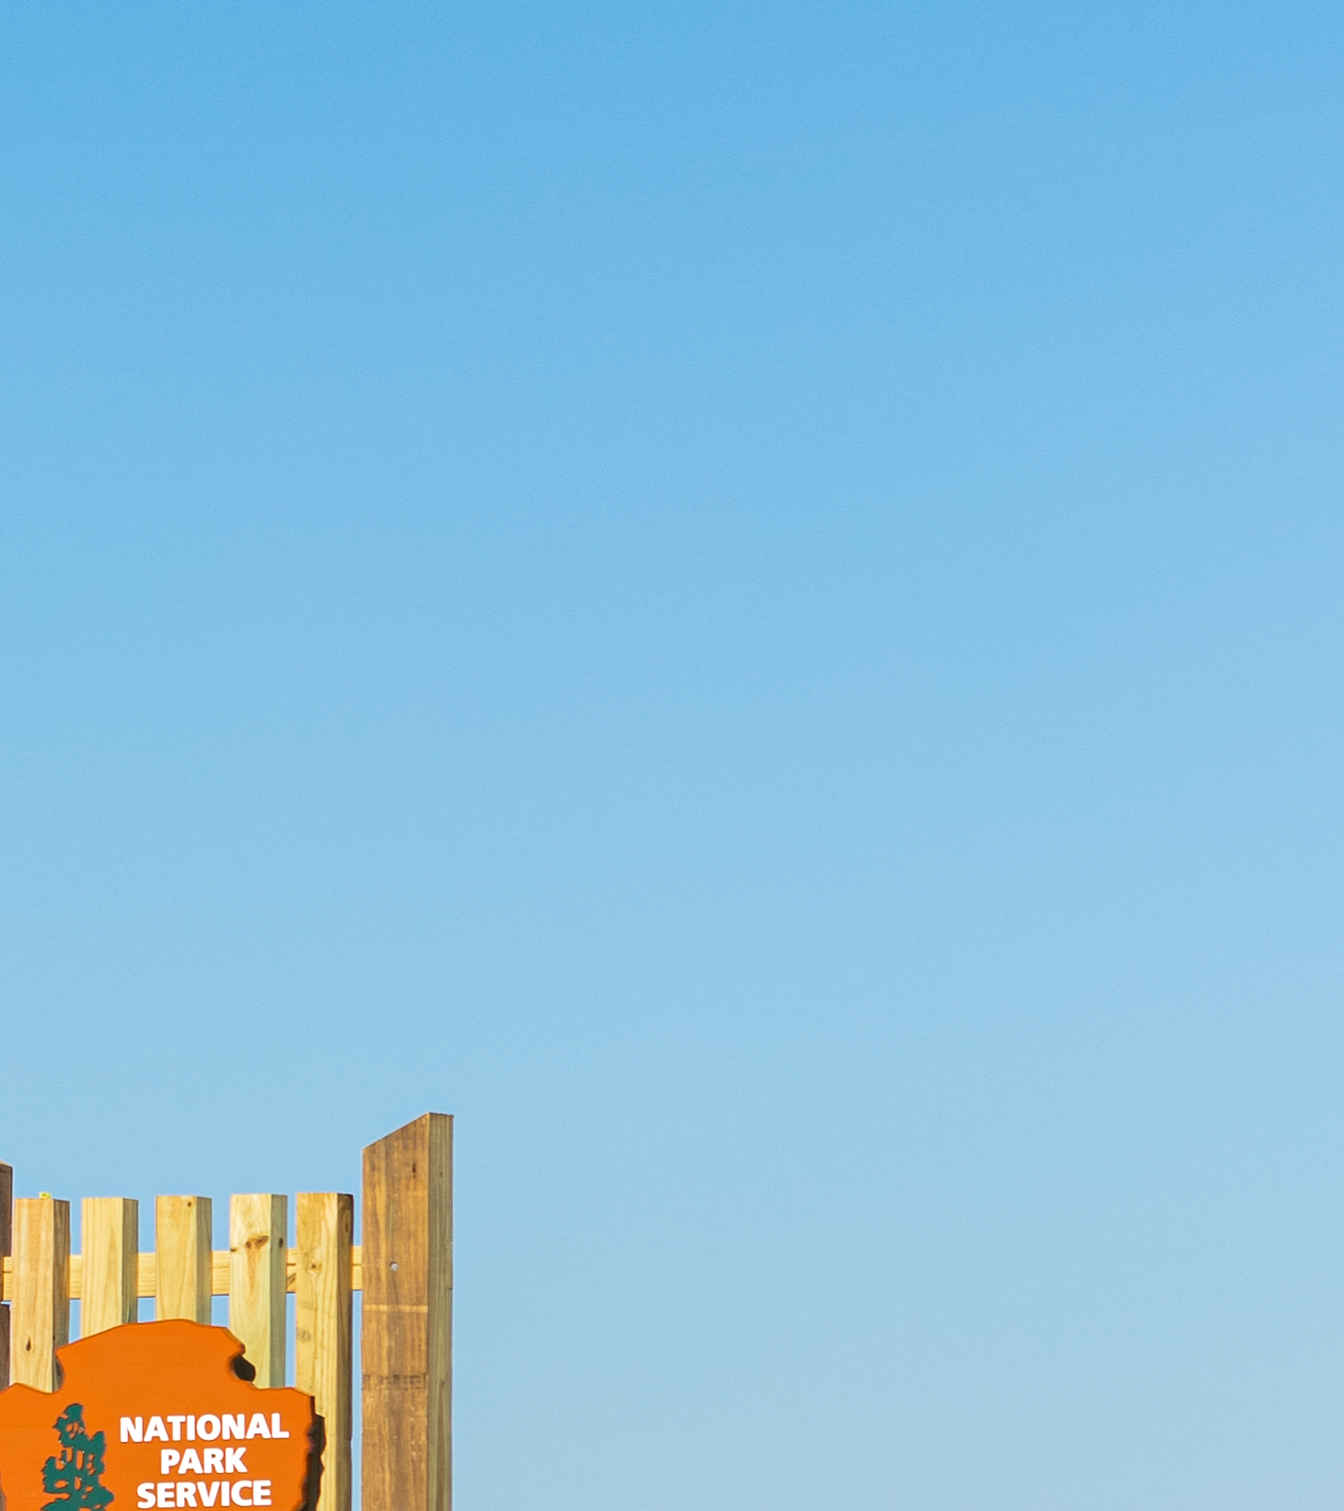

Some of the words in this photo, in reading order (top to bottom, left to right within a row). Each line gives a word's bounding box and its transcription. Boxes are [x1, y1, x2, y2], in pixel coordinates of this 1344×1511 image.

[119, 1412, 290, 1443] NATIONAL
[160, 1446, 248, 1475] PARK
[136, 1479, 272, 1509] SERVICE
